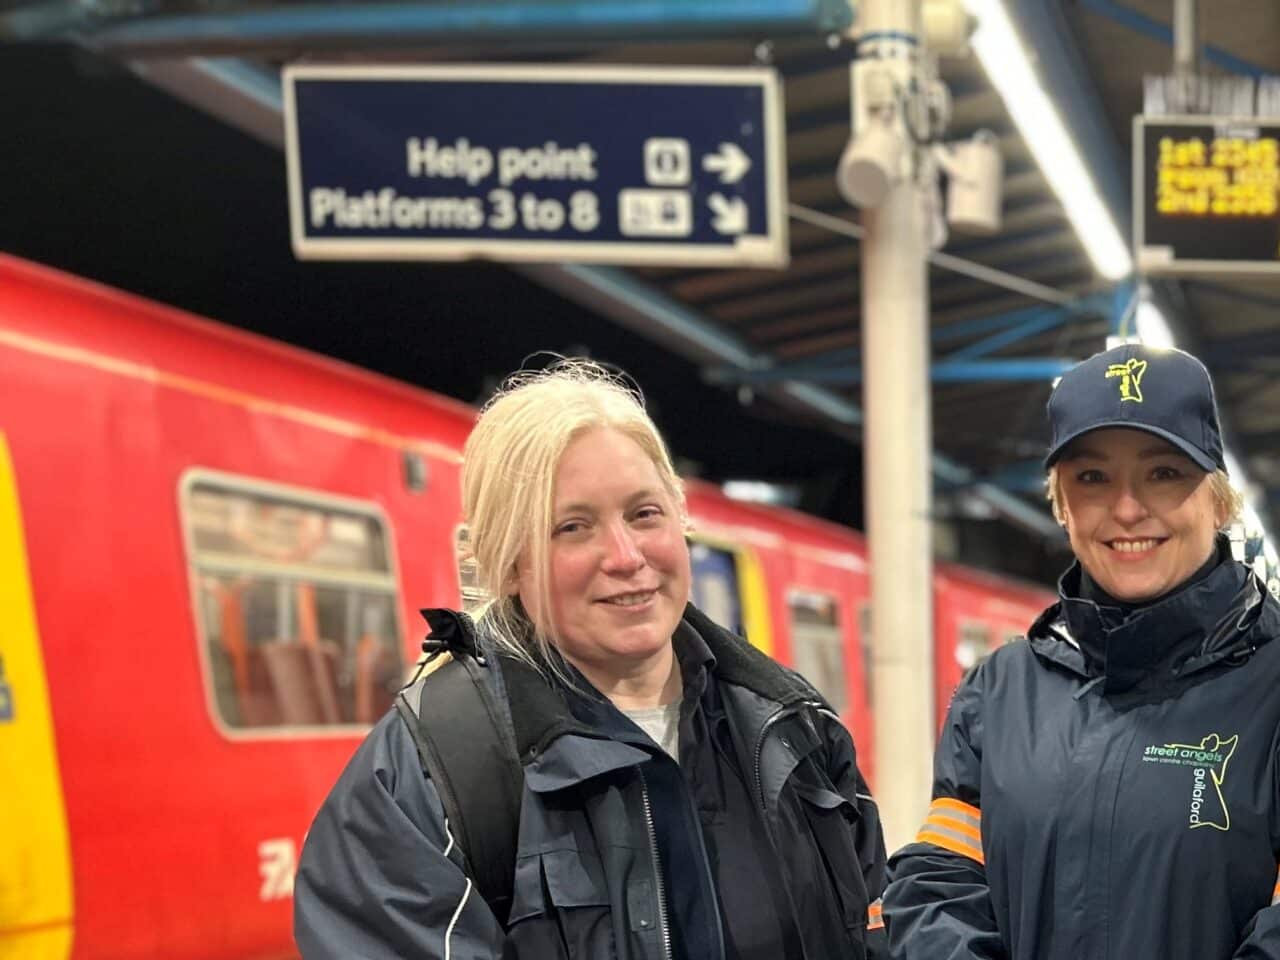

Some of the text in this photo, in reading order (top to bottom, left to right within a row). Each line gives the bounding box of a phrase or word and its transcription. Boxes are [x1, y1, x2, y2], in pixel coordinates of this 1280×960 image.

[407, 138, 597, 185] Help point
[309, 188, 599, 231] Platforms 3 to 8
[1144, 745, 1222, 762] street angels
